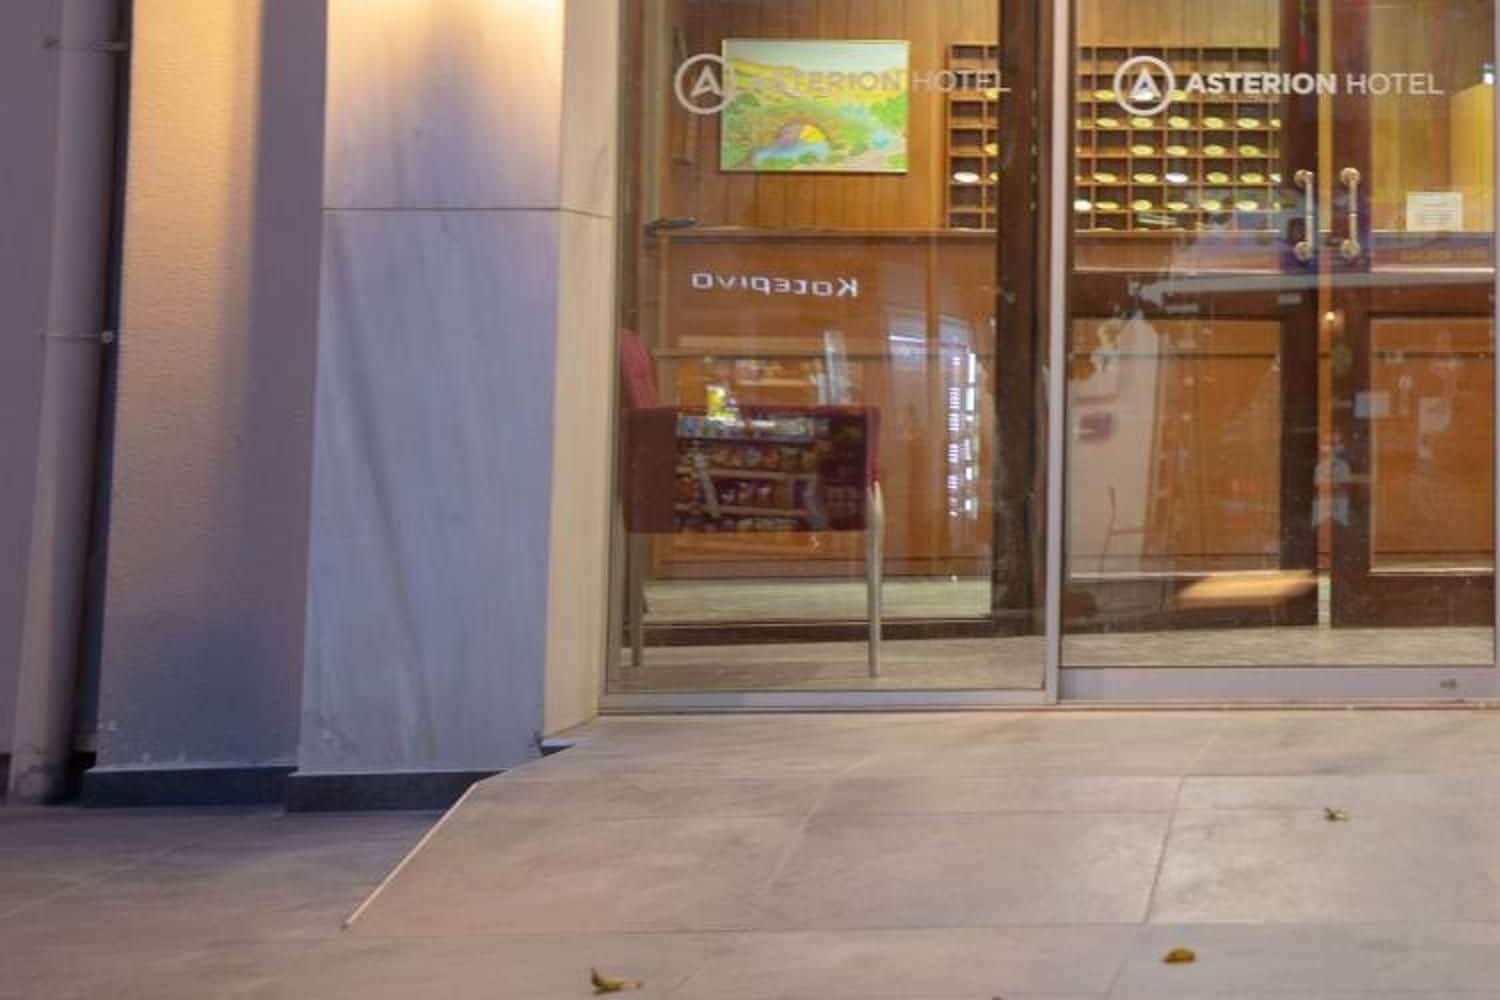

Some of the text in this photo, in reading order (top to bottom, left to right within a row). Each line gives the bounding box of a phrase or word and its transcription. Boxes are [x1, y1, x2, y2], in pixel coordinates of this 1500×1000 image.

[748, 71, 901, 93] TERION
[910, 70, 1011, 93] HOTEL
[1185, 73, 1336, 95] ASTERION
[1346, 73, 1444, 95] HOTEL
